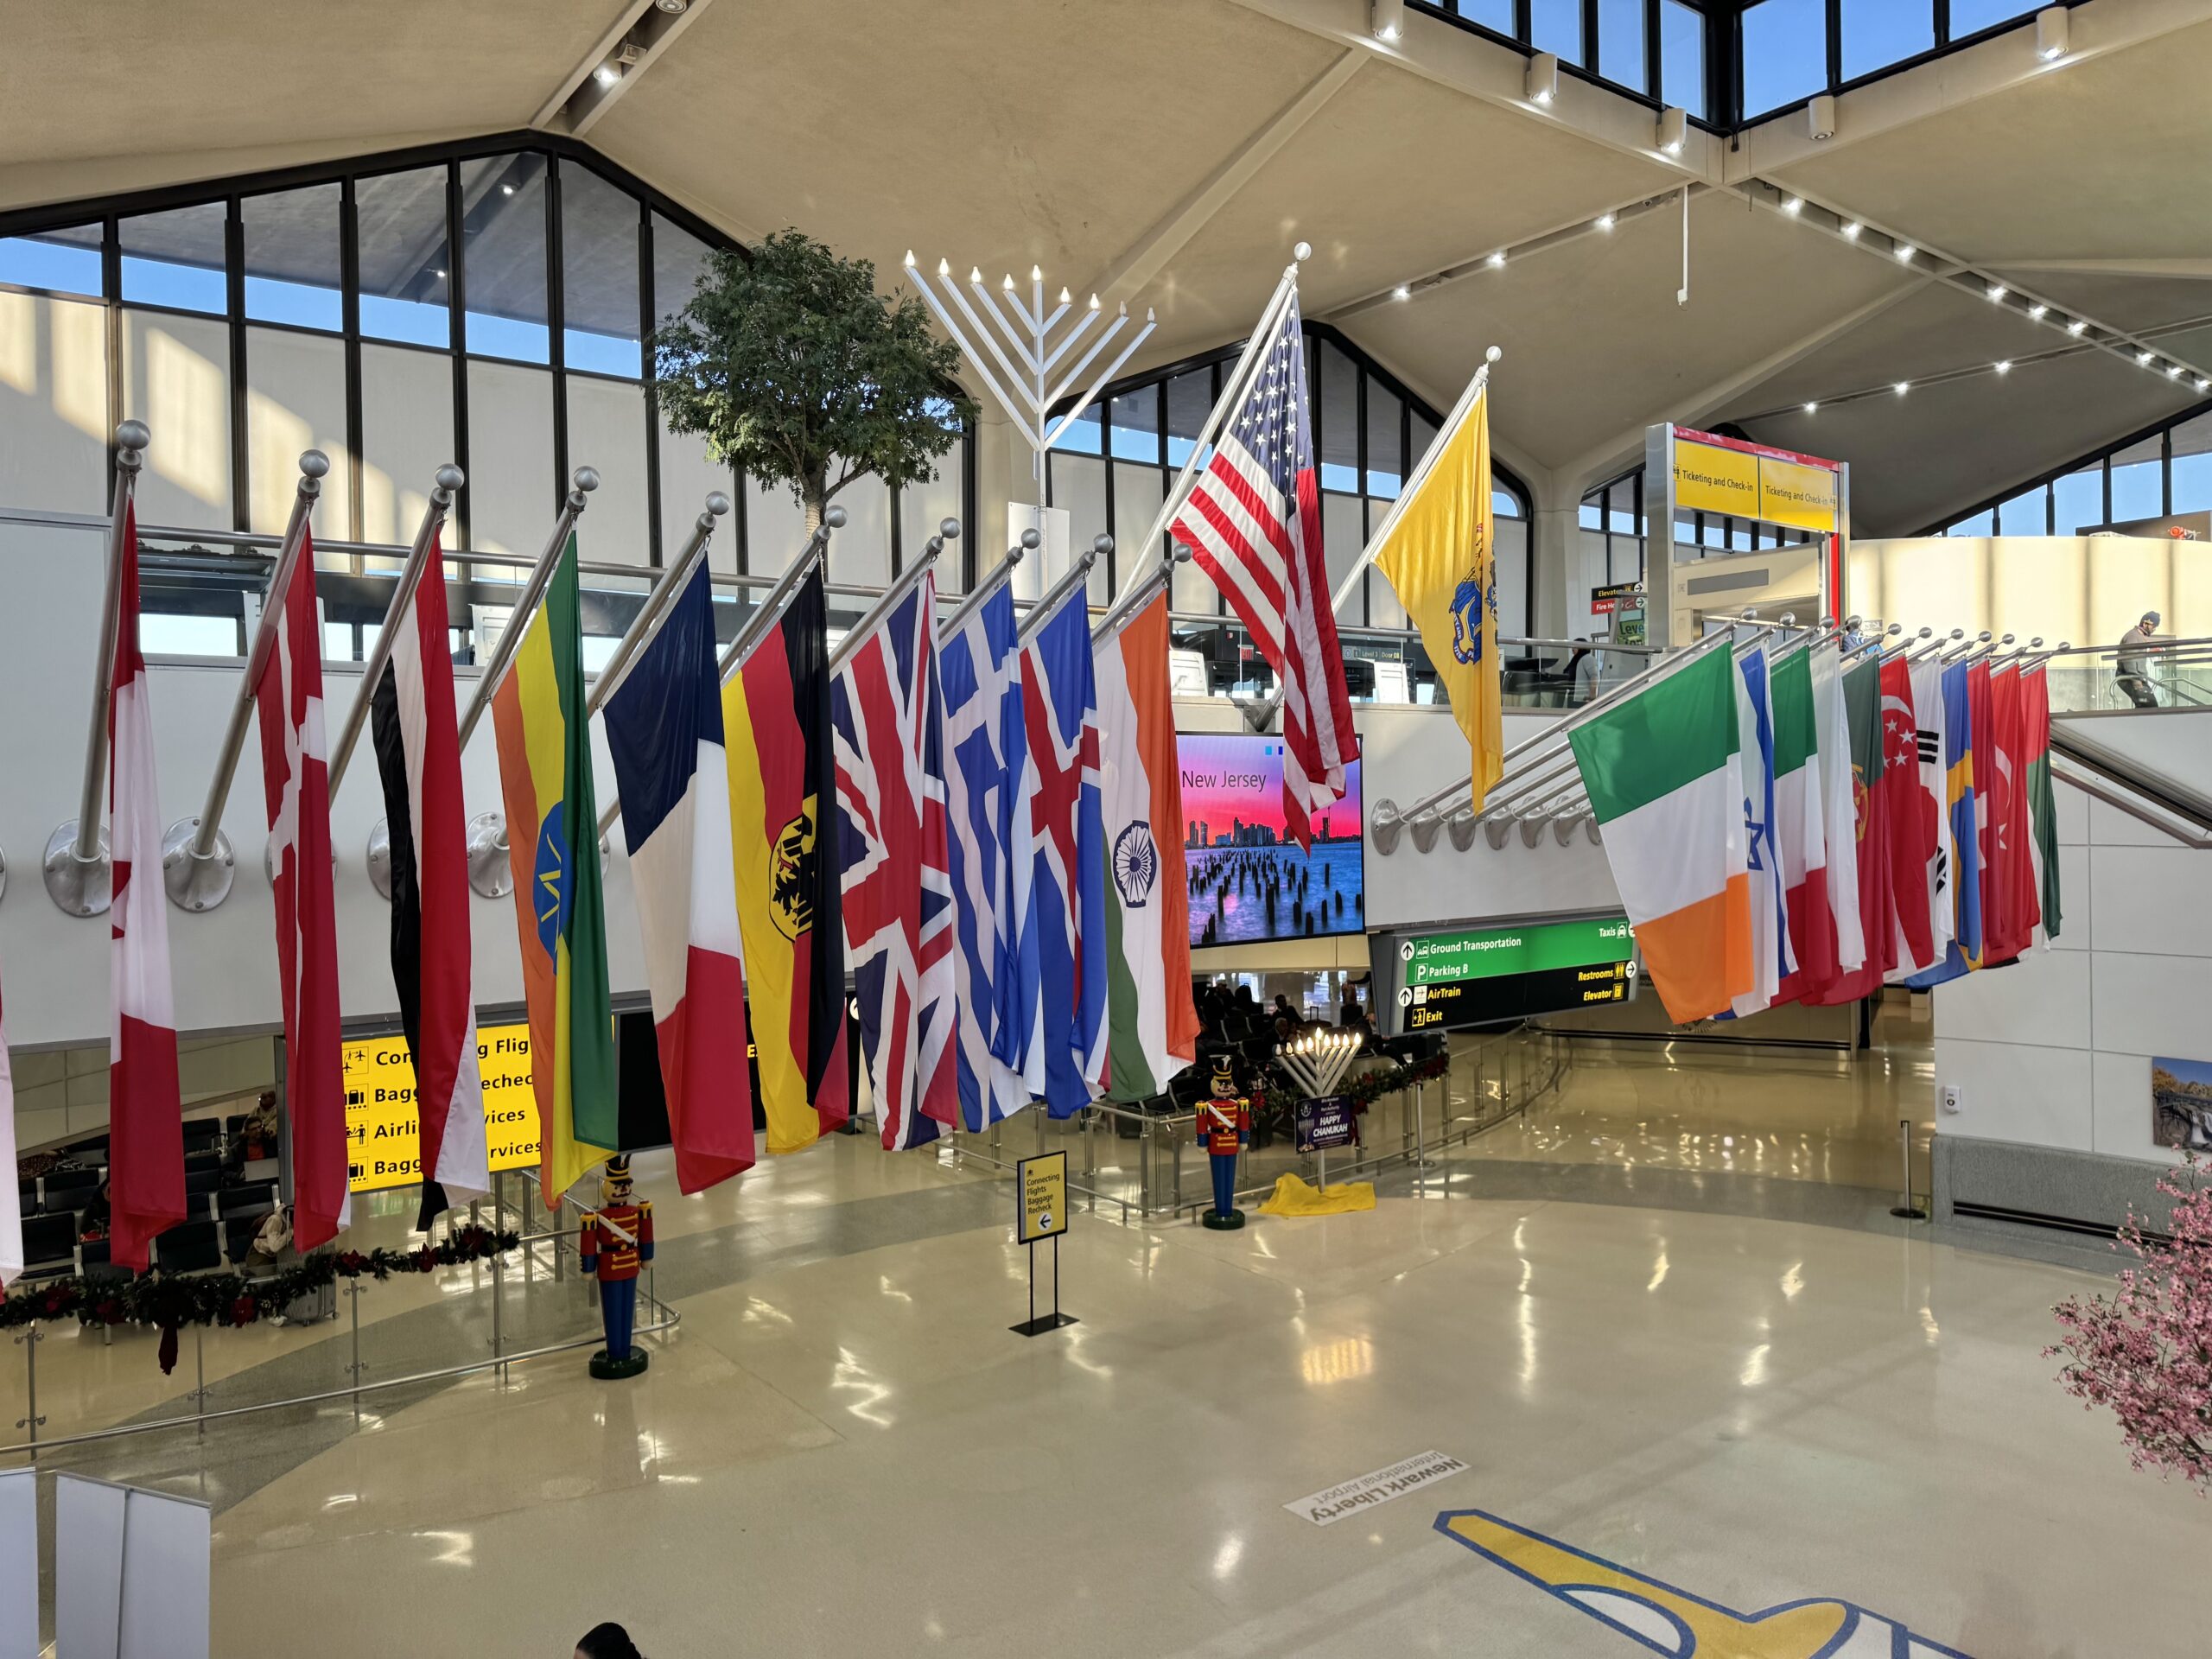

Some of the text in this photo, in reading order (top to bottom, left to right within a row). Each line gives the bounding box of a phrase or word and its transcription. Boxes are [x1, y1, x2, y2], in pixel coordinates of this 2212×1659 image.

[1682, 470, 1753, 493] Ticketing and Check-in
[1765, 485, 1828, 505] Ticketing and Check-in
[1619, 622, 1644, 635] Leve
[1182, 770, 1267, 792] New Jersey
[1599, 926, 1616, 938] Taxis
[1430, 938, 1522, 954] Ground Transportation
[1429, 964, 1460, 977] Parking
[1463, 963, 1469, 974] B
[1578, 969, 1614, 982] Restrooms
[1427, 987, 1461, 1000] AirTrain
[1583, 990, 1612, 1001] Elevator
[1427, 1011, 1443, 1022] Exit
[496, 1038, 530, 1054] Flig
[480, 1074, 533, 1090] echec
[374, 1109, 525, 1140] Airli vices
[1319, 1114, 1341, 1126] HAPPY
[1313, 1123, 1348, 1138] CHANUKAH
[374, 1141, 542, 1175] Bagg rvices
[1027, 1173, 1060, 1186] Connecting
[1027, 1185, 1046, 1197] Flights
[1027, 1194, 1053, 1205] Baggage
[1027, 1203, 1052, 1215] Recheck
[1313, 1452, 1445, 1505] International Airport
[1310, 1459, 1464, 1522] Newark Liberty
